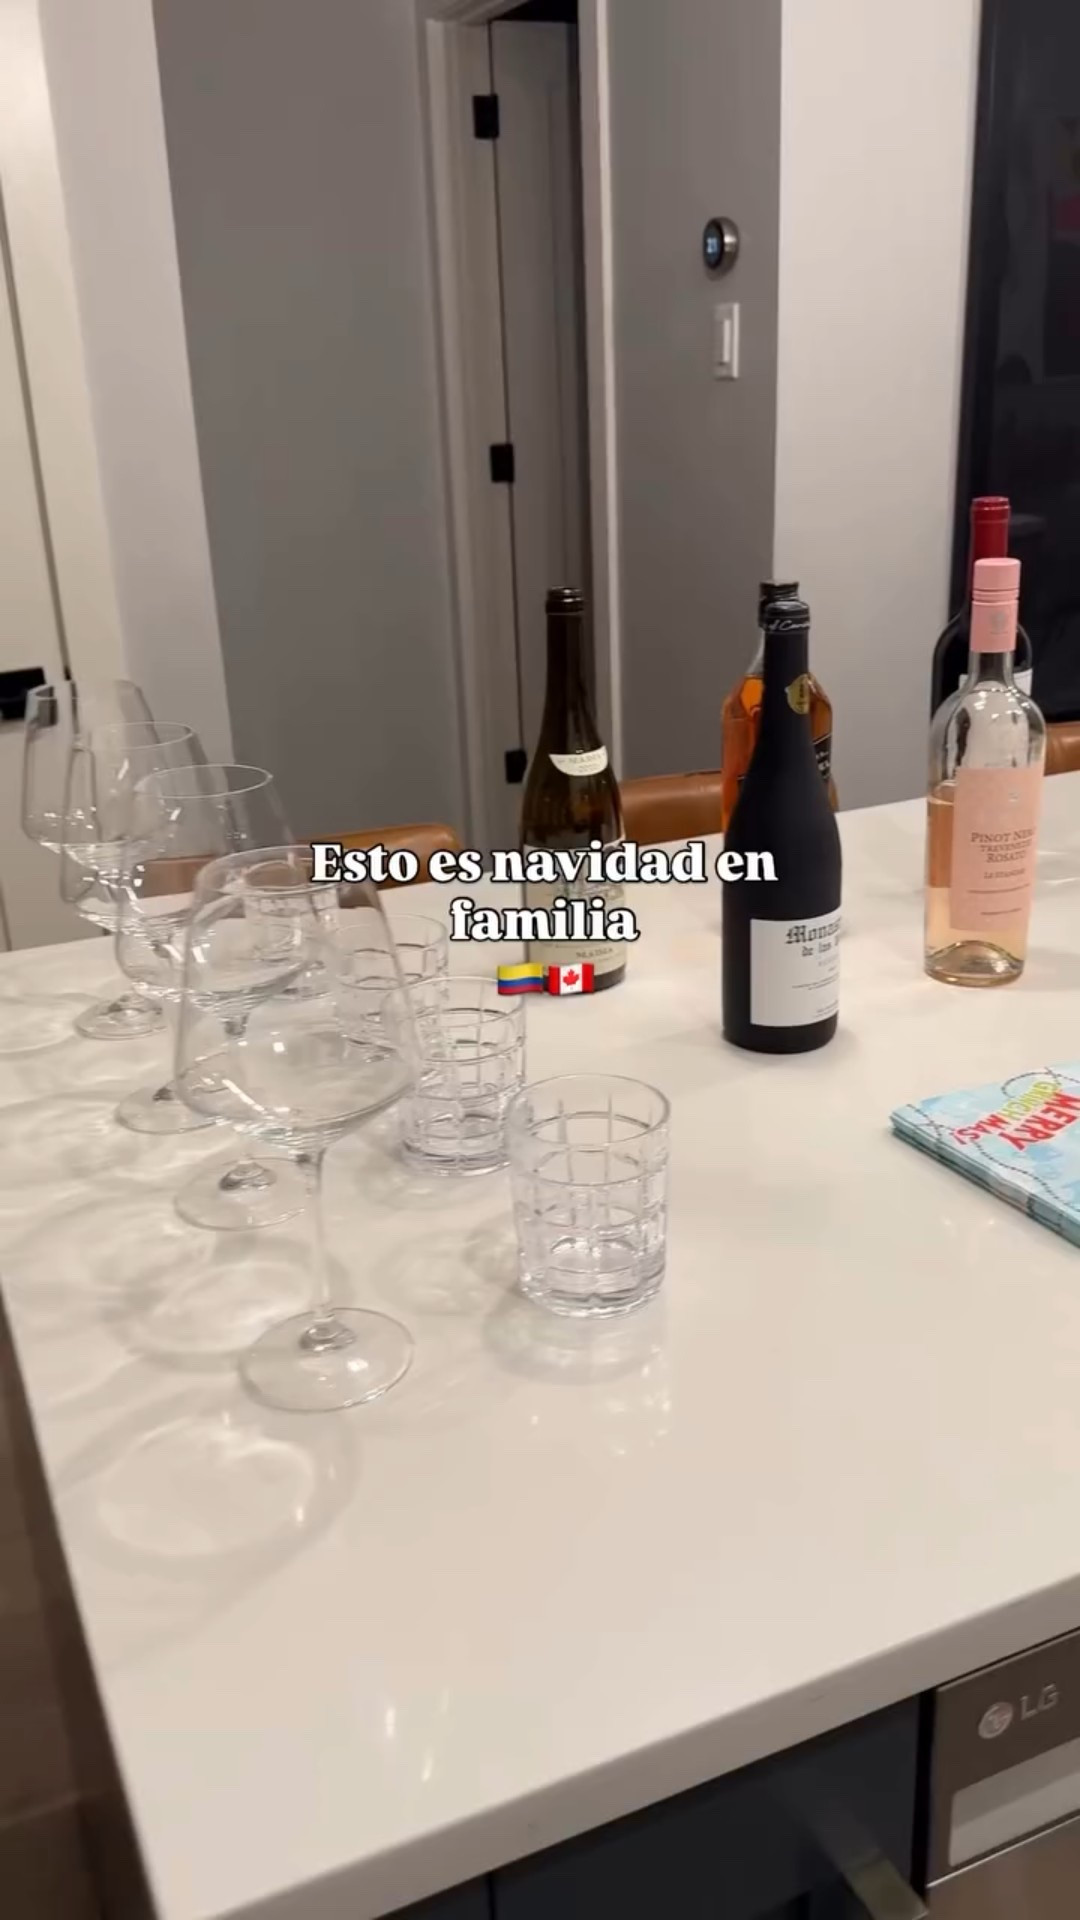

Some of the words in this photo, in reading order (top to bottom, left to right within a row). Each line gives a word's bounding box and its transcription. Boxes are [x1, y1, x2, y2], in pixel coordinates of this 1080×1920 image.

[970, 831, 1011, 844] PINOT
[997, 1089, 1080, 1151] MERRY
[1020, 1683, 1060, 1721] LG
